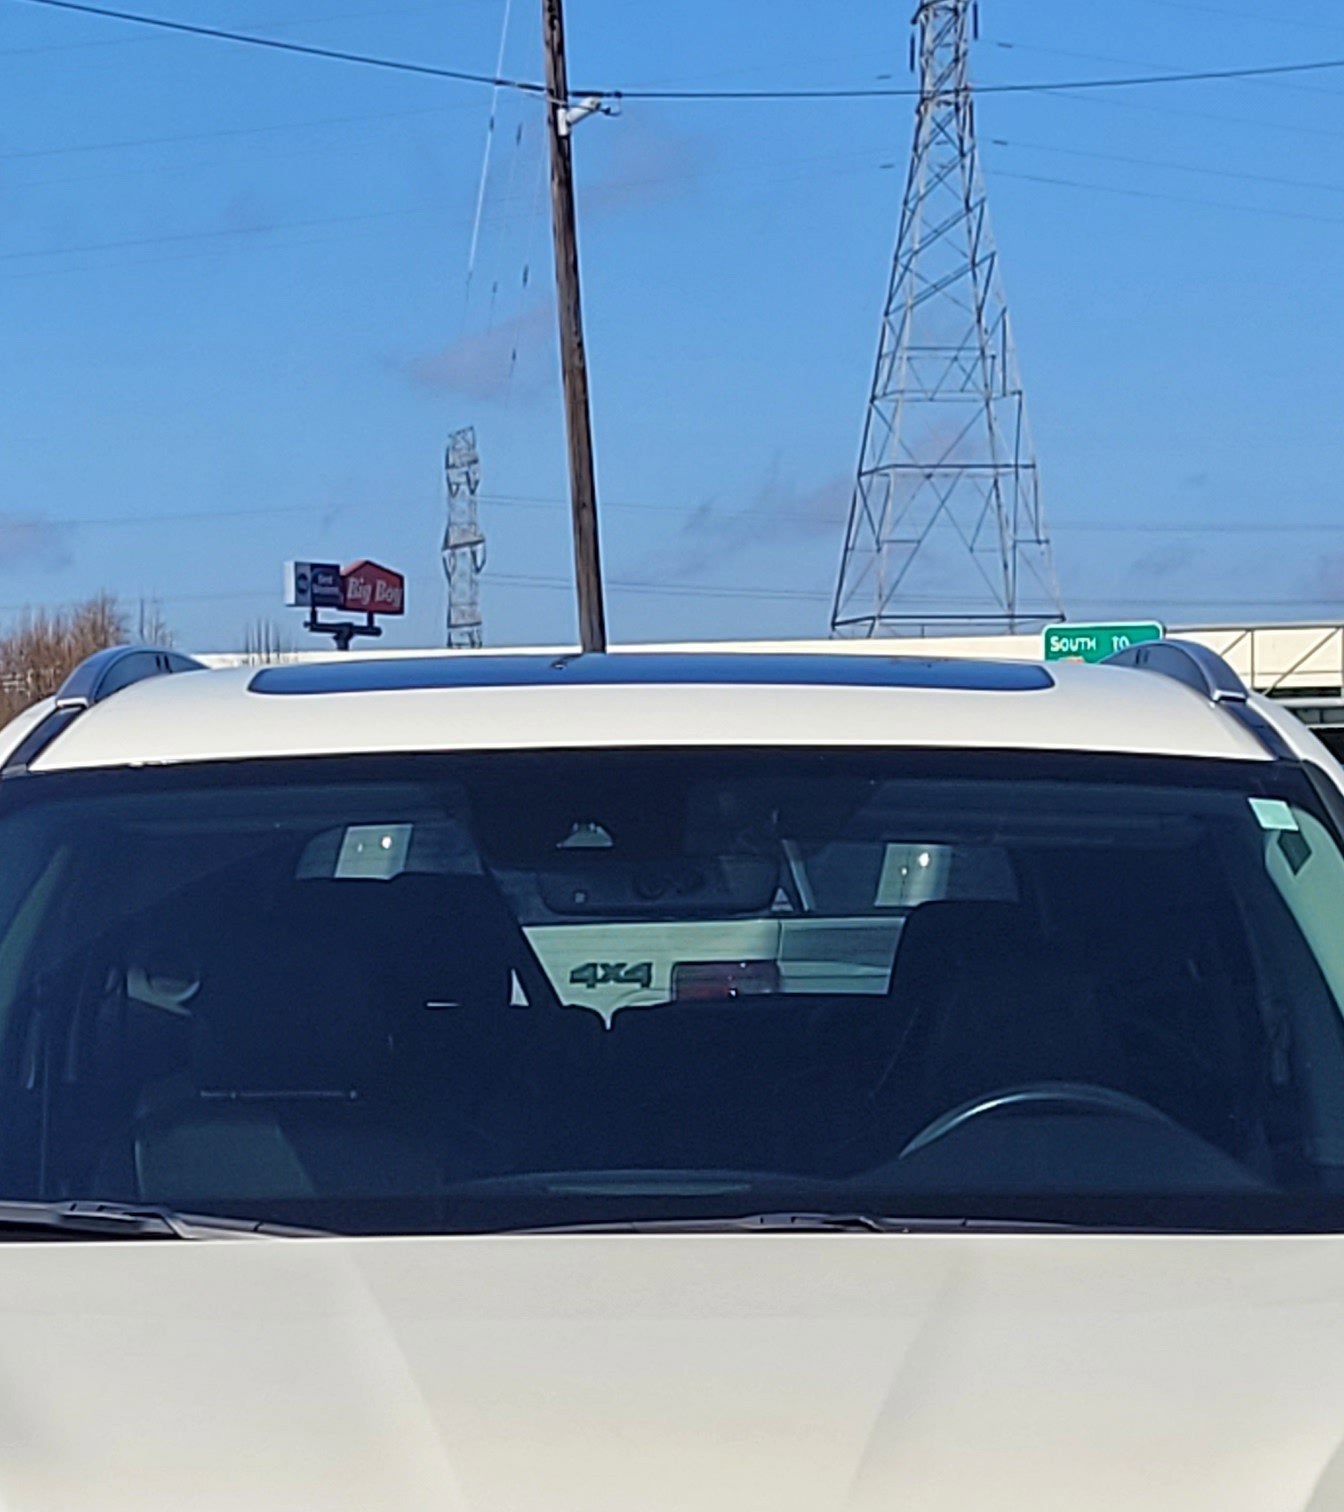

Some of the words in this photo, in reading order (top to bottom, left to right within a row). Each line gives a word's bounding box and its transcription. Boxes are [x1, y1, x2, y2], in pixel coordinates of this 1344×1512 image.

[347, 577, 372, 606] Big
[375, 580, 403, 607] Boy
[1050, 635, 1096, 652] SOUTH
